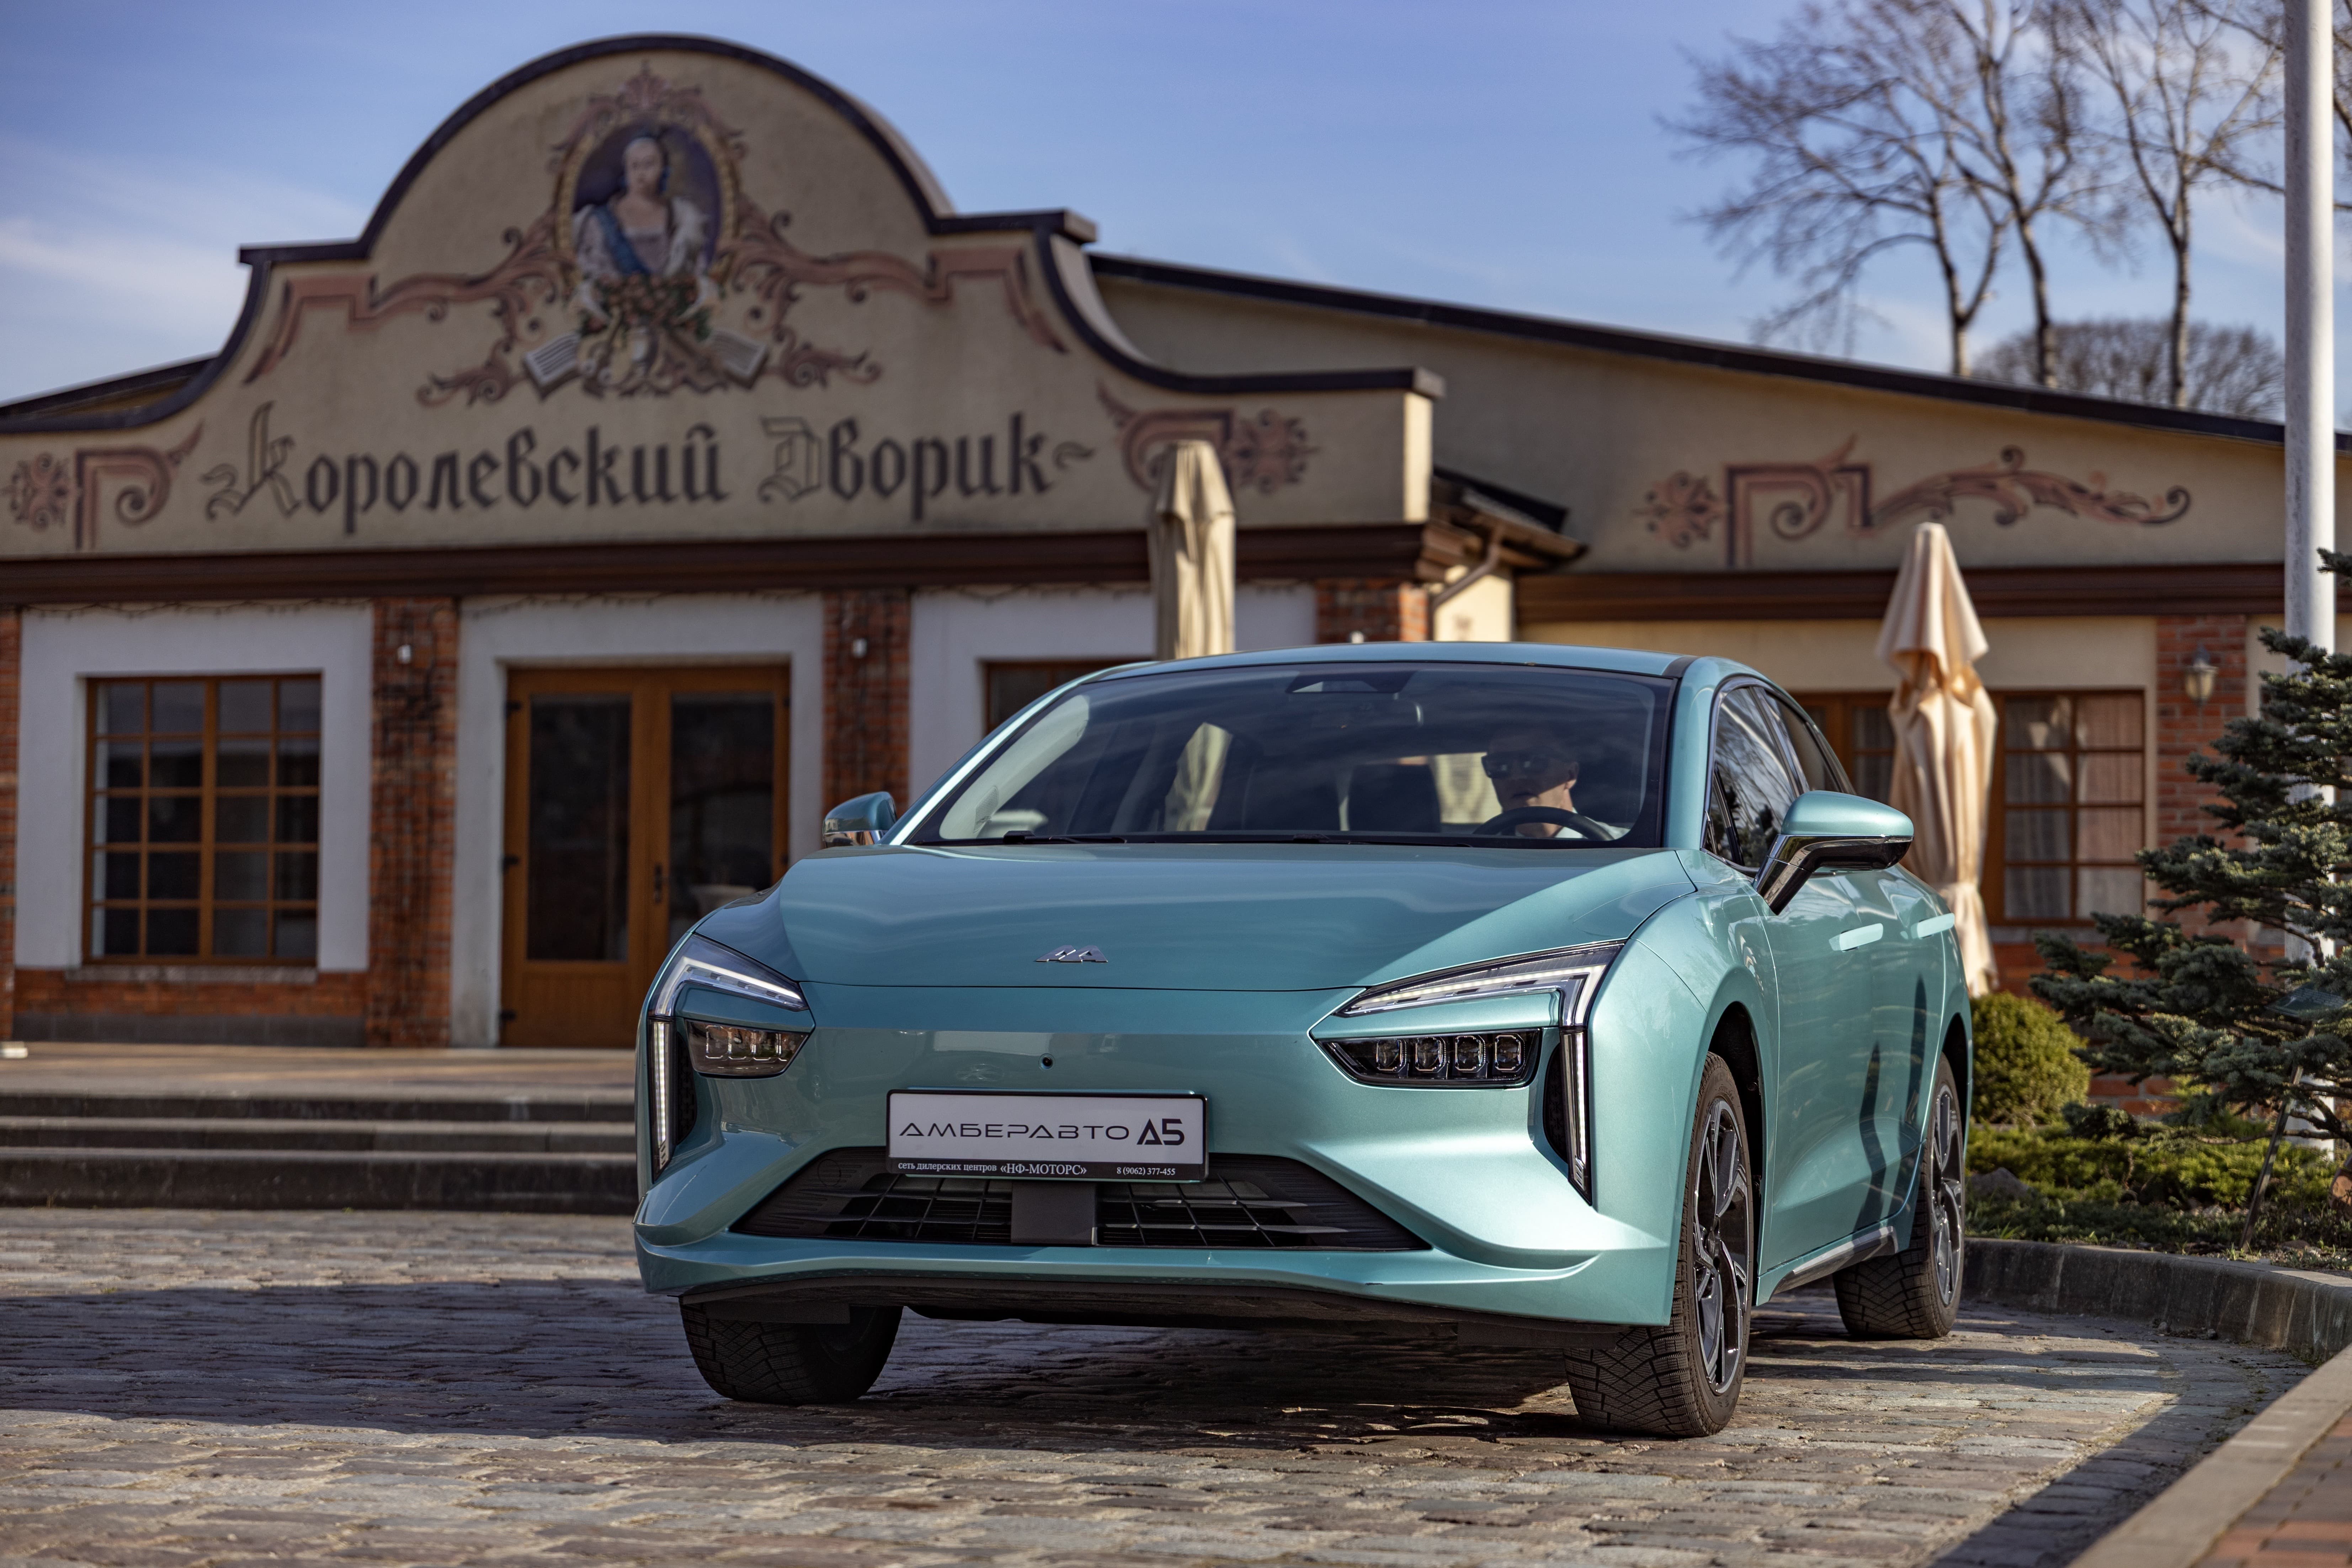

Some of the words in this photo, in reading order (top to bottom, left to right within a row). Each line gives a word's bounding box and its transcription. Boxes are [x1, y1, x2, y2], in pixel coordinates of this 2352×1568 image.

[200, 400, 730, 534] Королевский
[756, 410, 1058, 523] Дворик
[899, 1122, 1129, 1139] АМБЕРАВТО
[916, 1163, 961, 1171] дилерских
[963, 1164, 997, 1173] центров
[1000, 1163, 1087, 1175] «НФ-МОТОРС»
[1123, 1166, 1145, 1175] (9062)
